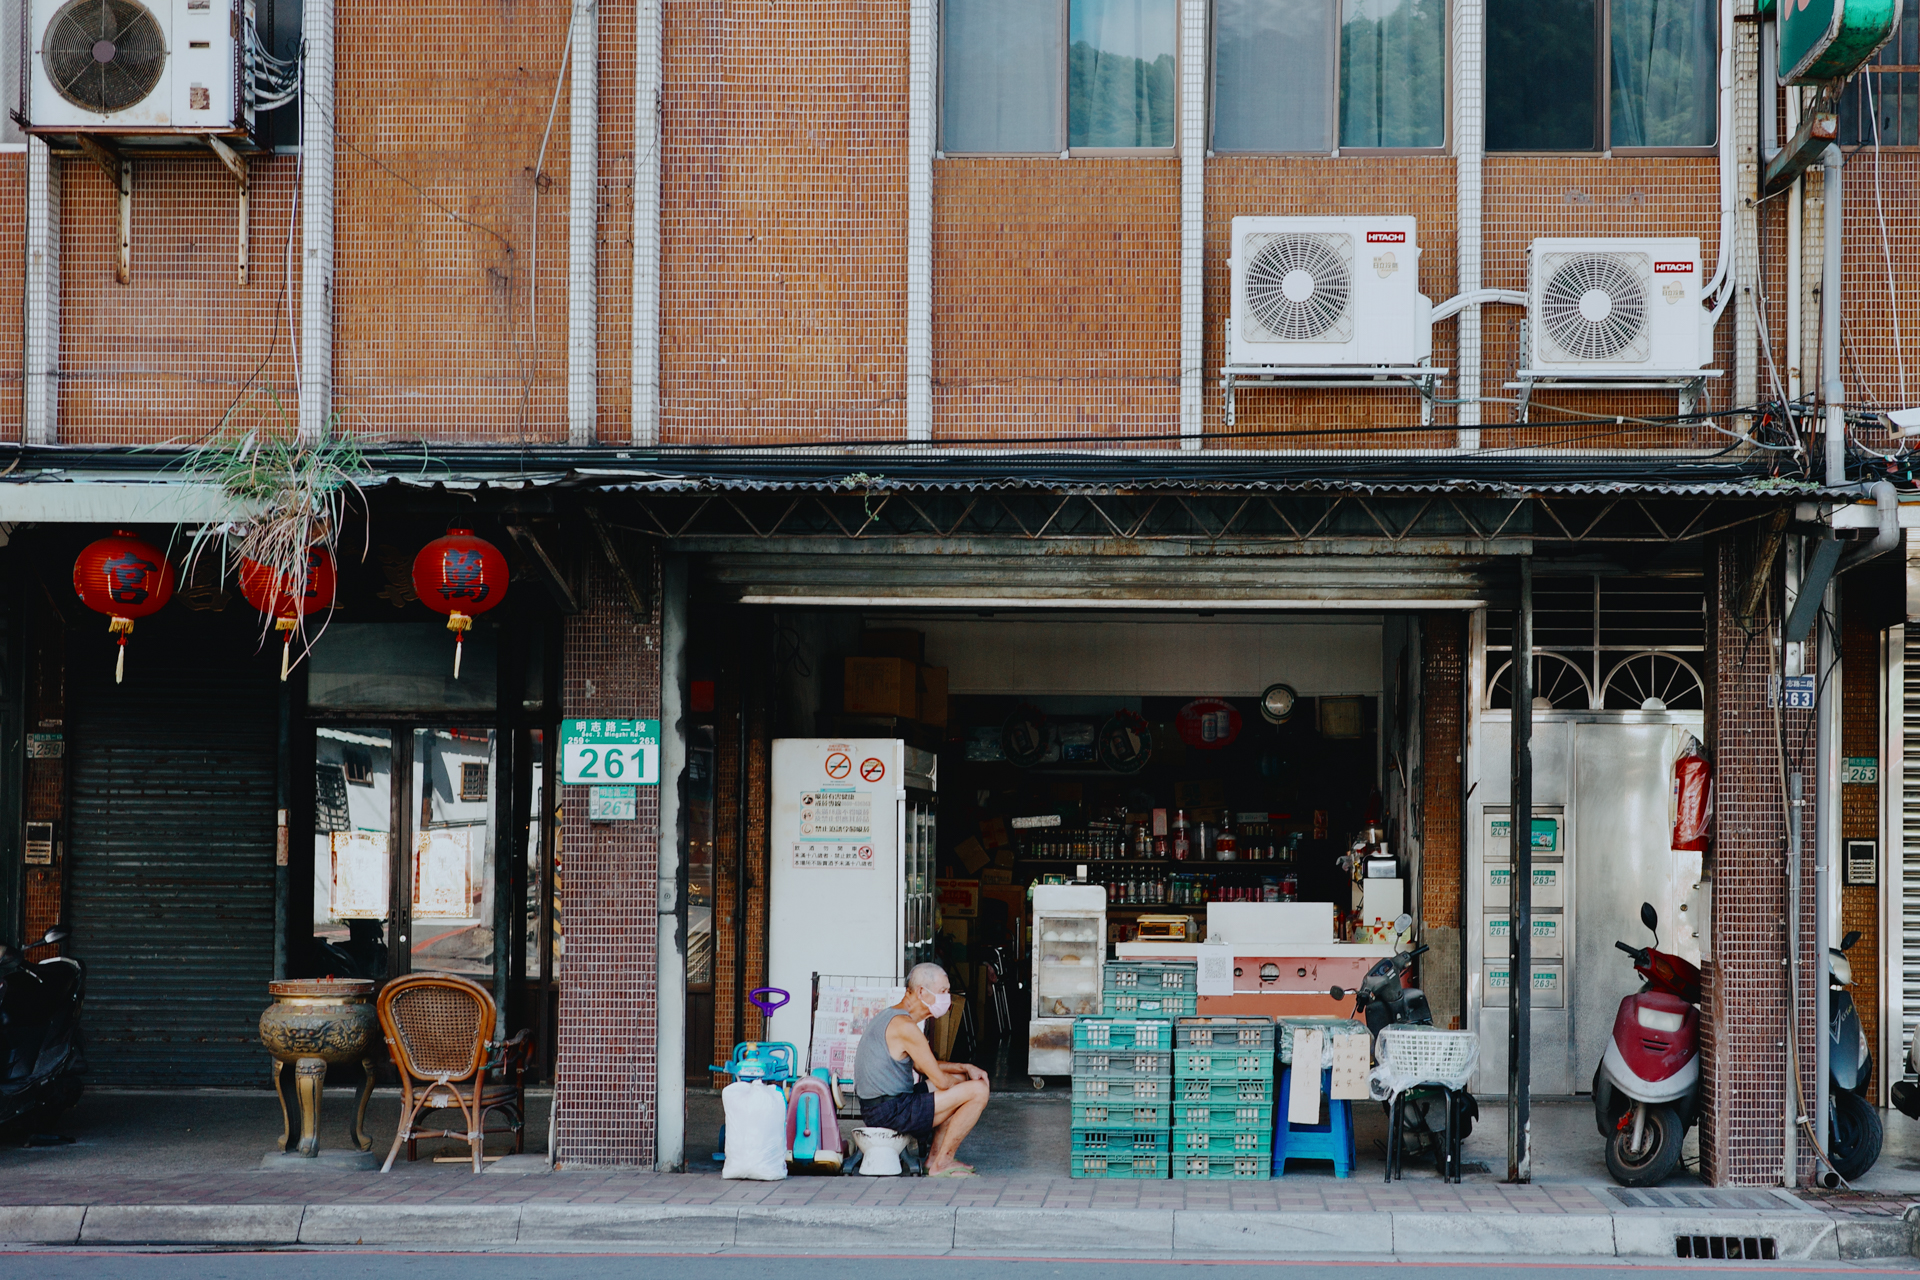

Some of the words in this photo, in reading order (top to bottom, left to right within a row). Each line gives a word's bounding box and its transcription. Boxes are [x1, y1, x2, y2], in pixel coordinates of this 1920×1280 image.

[1368, 233, 1404, 241] HITACHI
[1656, 263, 1692, 271] HITACHI
[1779, 680, 1813, 688] 志路二段
[576, 721, 646, 732] 明志路二段
[639, 737, 655, 745] 263
[36, 744, 60, 755] 259
[578, 748, 644, 778] 261
[1851, 768, 1876, 781] 263
[601, 801, 632, 815] 261
[1534, 877, 1549, 885] 263
[1491, 978, 1505, 986] 261
